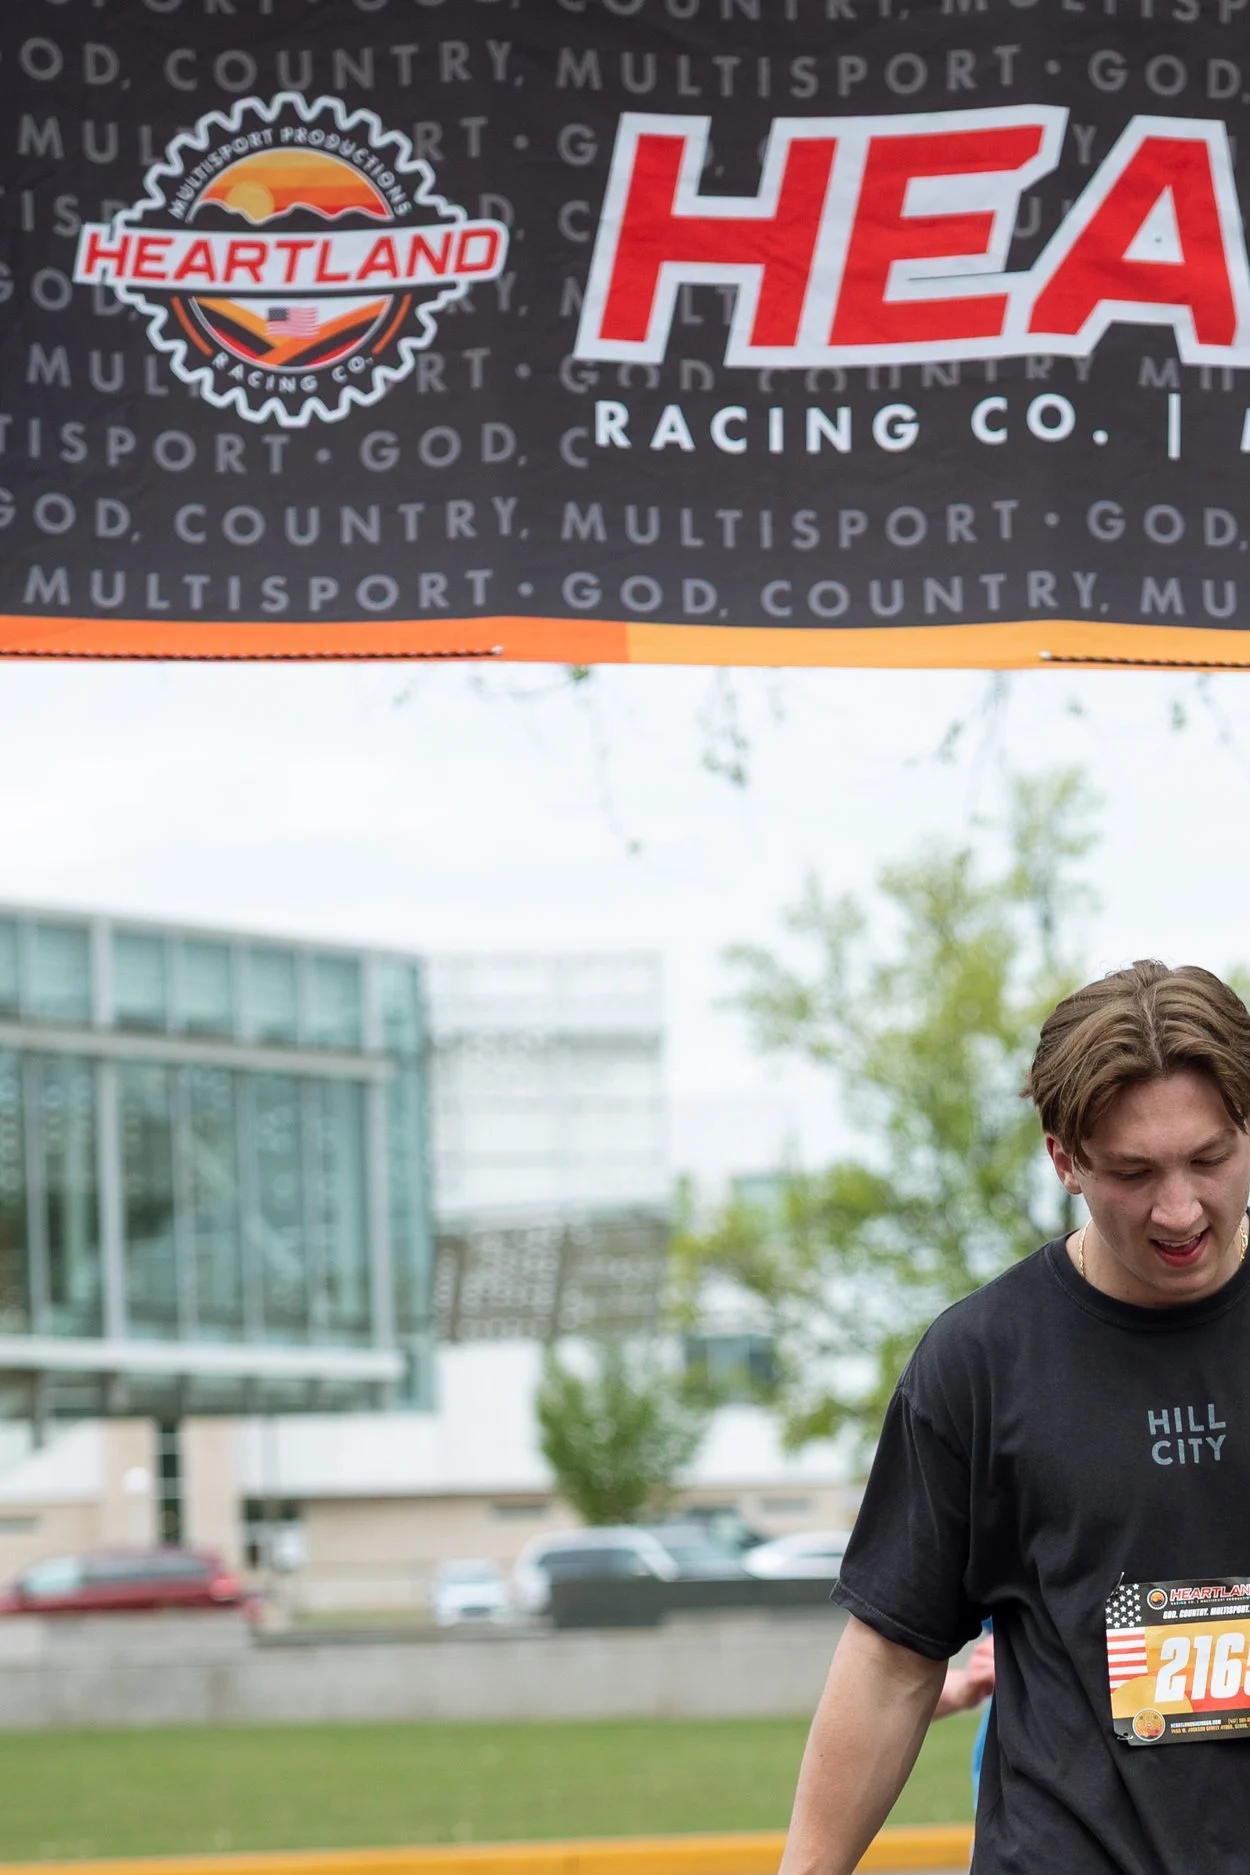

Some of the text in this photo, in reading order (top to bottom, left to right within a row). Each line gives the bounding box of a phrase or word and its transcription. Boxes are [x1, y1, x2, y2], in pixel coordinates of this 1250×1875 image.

[0, 36, 1020, 98] OD, COUNTRY, MULTISPORT
[1088, 50, 1250, 103] GOD,
[168, 127, 275, 220] MULTISPORT
[278, 125, 414, 218] PRODUCTIONS
[82, 226, 501, 283] HEARTLAND
[209, 351, 318, 393] RACING
[360, 422, 528, 471] GOD,
[594, 399, 920, 454] RACING
[969, 393, 1109, 446] CO.
[174, 496, 529, 546] COUNTRY,
[560, 499, 1018, 550] MULTISPORT
[1086, 500, 1249, 551] GOD,
[24, 565, 494, 613] MULTISPORT
[561, 571, 729, 619] GOD,
[760, 569, 1109, 619] COUNTRY,
[1147, 1403, 1226, 1435] HILL
[1151, 1434, 1227, 1466] CITY
